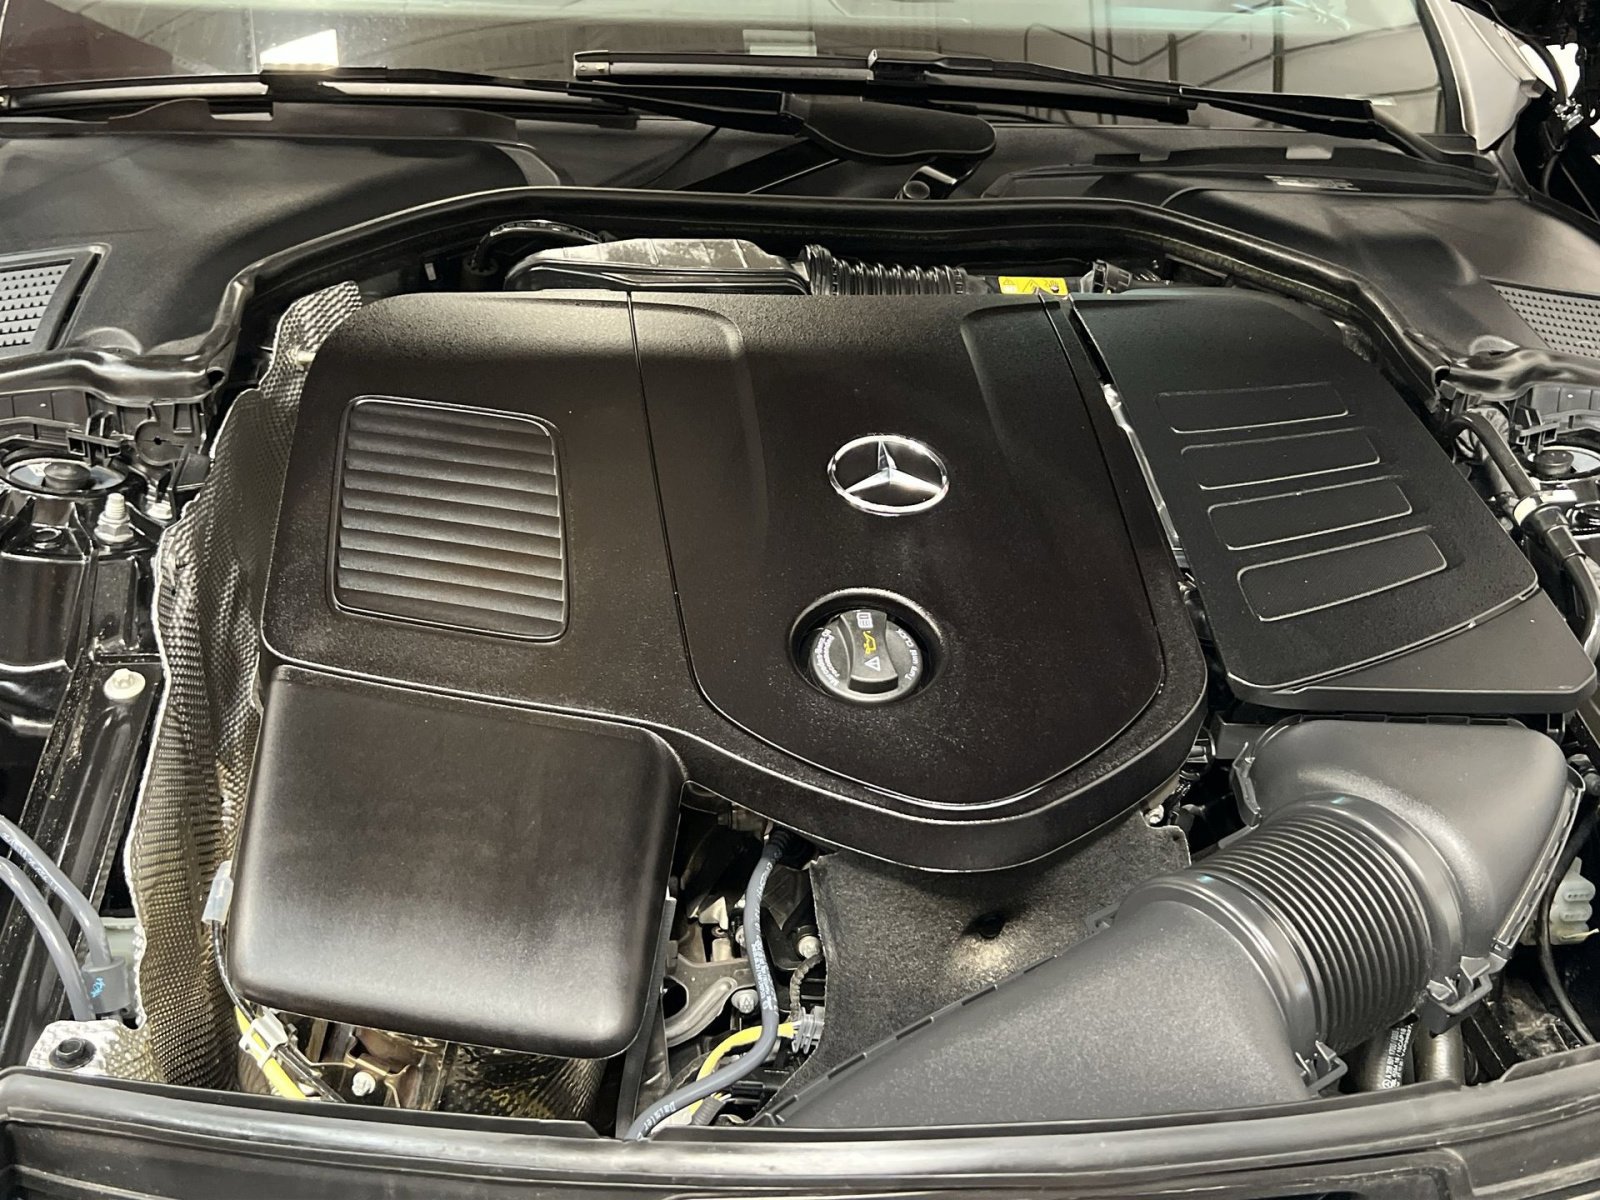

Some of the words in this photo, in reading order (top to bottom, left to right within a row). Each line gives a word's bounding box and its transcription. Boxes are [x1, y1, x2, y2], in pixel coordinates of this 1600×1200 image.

[895, 628, 915, 648] CLICK
[909, 649, 919, 665] until
[904, 665, 919, 681] Turn
[643, 1101, 677, 1131] Daimler
